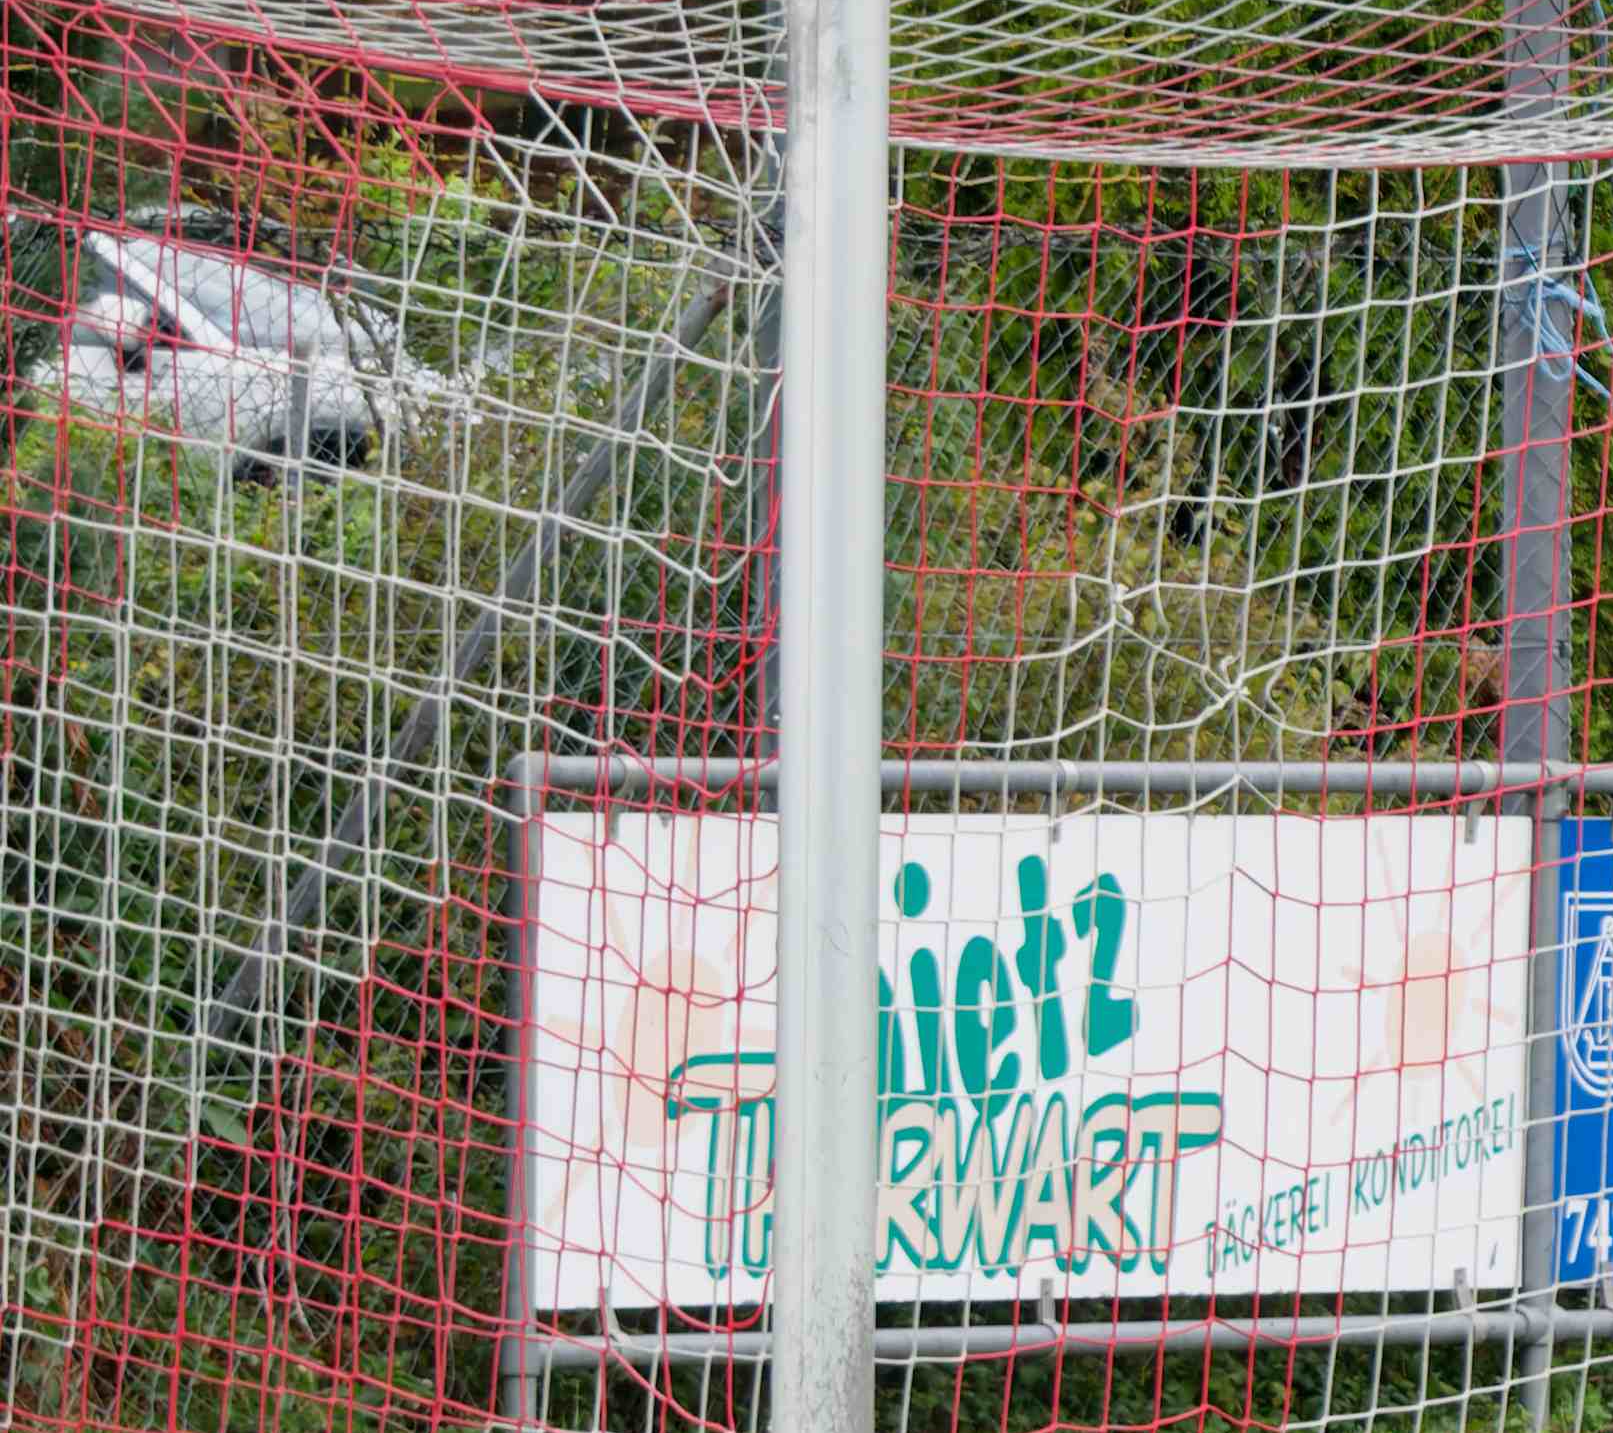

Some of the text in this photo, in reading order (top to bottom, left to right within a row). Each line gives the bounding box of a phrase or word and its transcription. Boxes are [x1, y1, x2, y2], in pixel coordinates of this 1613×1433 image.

[871, 855, 1139, 1118] ietz
[666, 1052, 1223, 1279] TRWART
[1204, 1092, 1516, 1278] BÄCKEREI KONDITOREI
